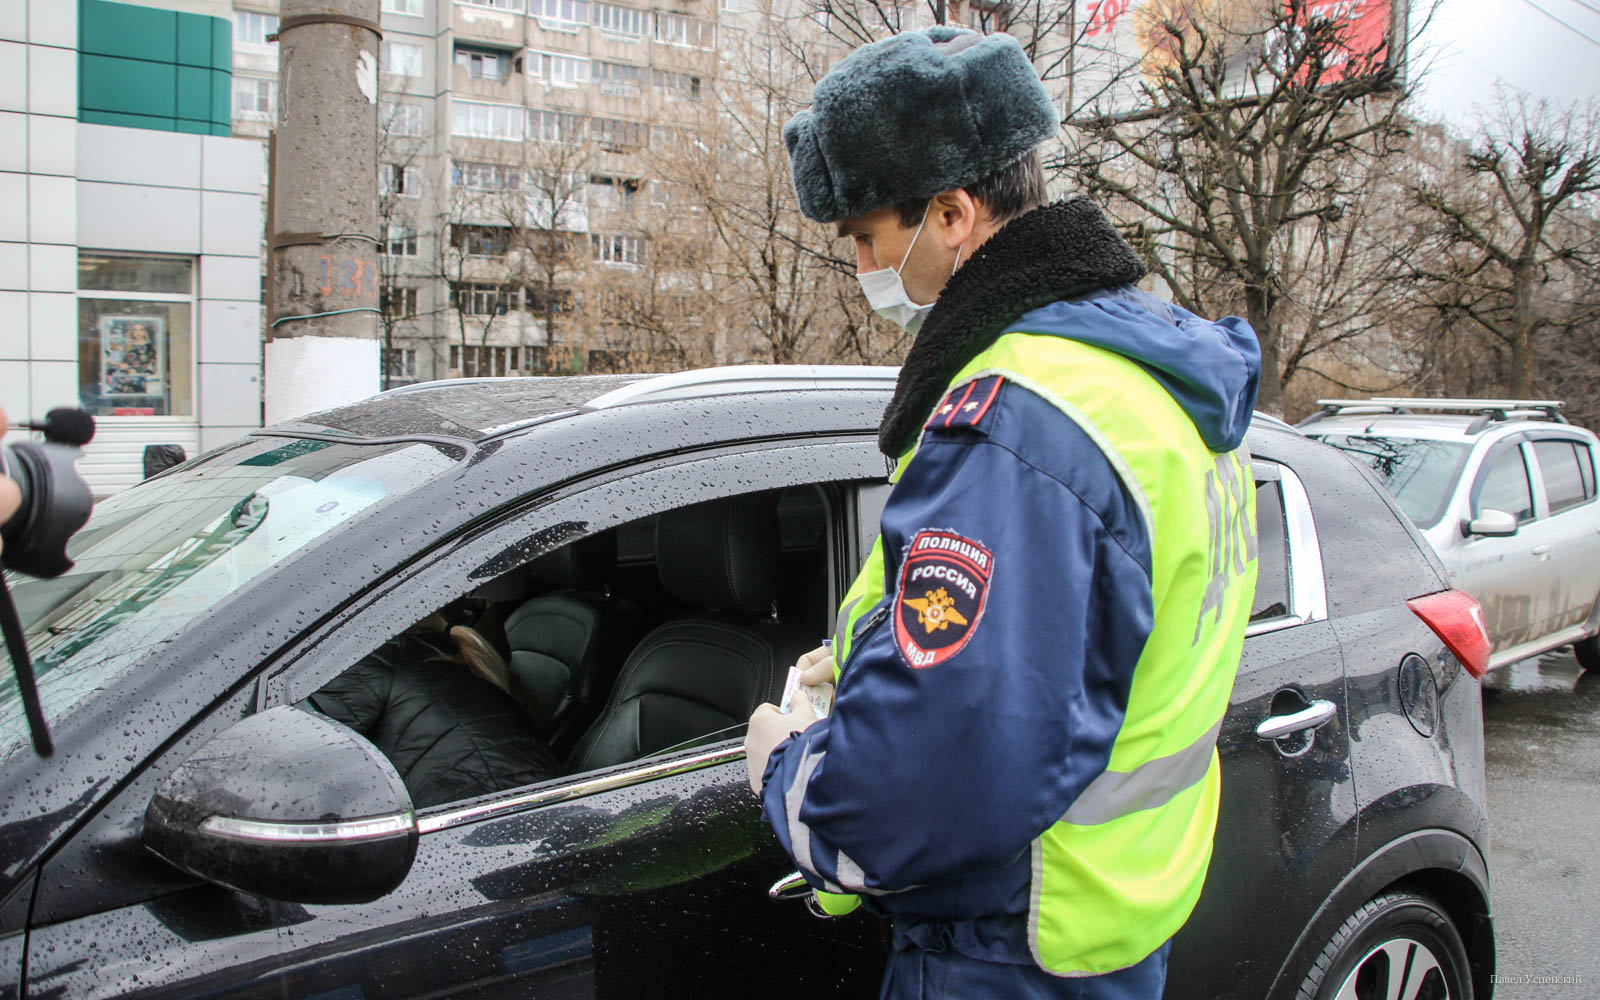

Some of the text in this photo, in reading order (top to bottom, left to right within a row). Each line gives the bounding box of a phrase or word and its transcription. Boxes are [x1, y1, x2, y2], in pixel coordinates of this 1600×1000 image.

[918, 537, 988, 569] ПОЛИЦИЯ
[911, 566, 977, 599] РОССИЯ
[906, 641, 936, 666] МВД
